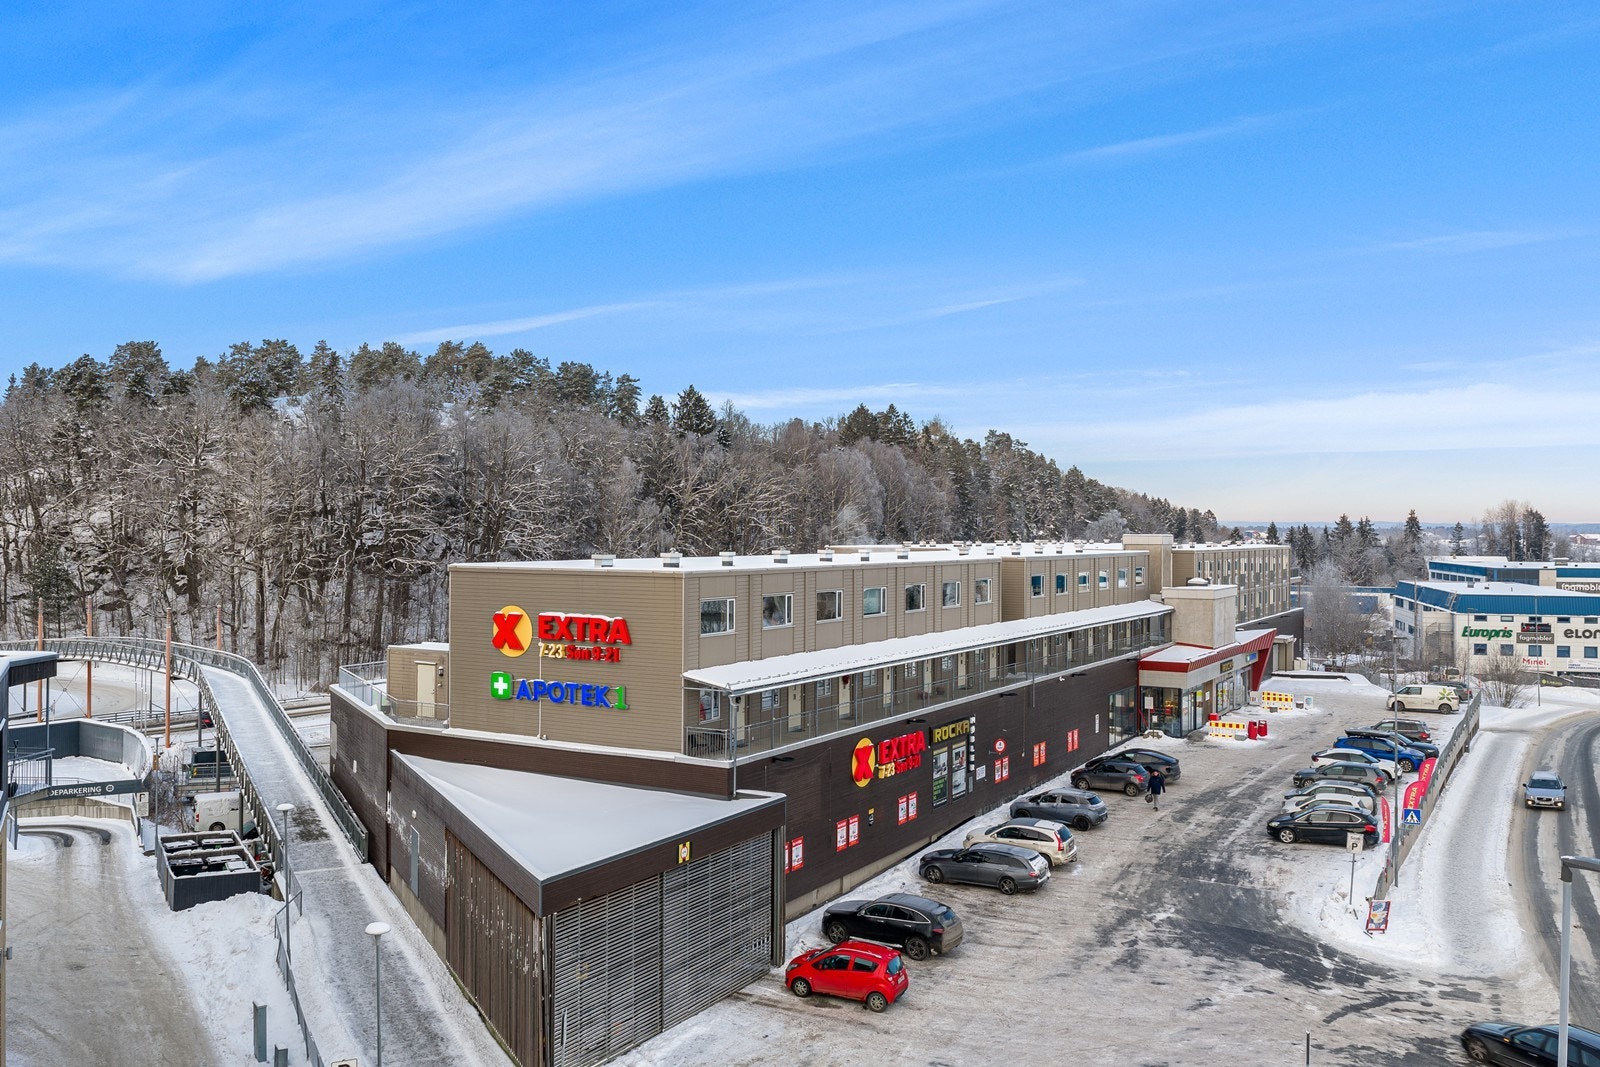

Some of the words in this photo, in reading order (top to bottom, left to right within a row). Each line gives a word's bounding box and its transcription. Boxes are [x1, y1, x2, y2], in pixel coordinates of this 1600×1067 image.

[538, 614, 632, 645] EXTRA
[1462, 626, 1513, 641] Europris
[516, 679, 611, 708] APOTEK
[614, 686, 628, 709] 1
[933, 720, 970, 743] ROCKA
[878, 730, 926, 765] EXTRA
[1421, 763, 1431, 782] XTRA
[1407, 787, 1418, 809] EXTRA
[1351, 842, 1358, 850] P
